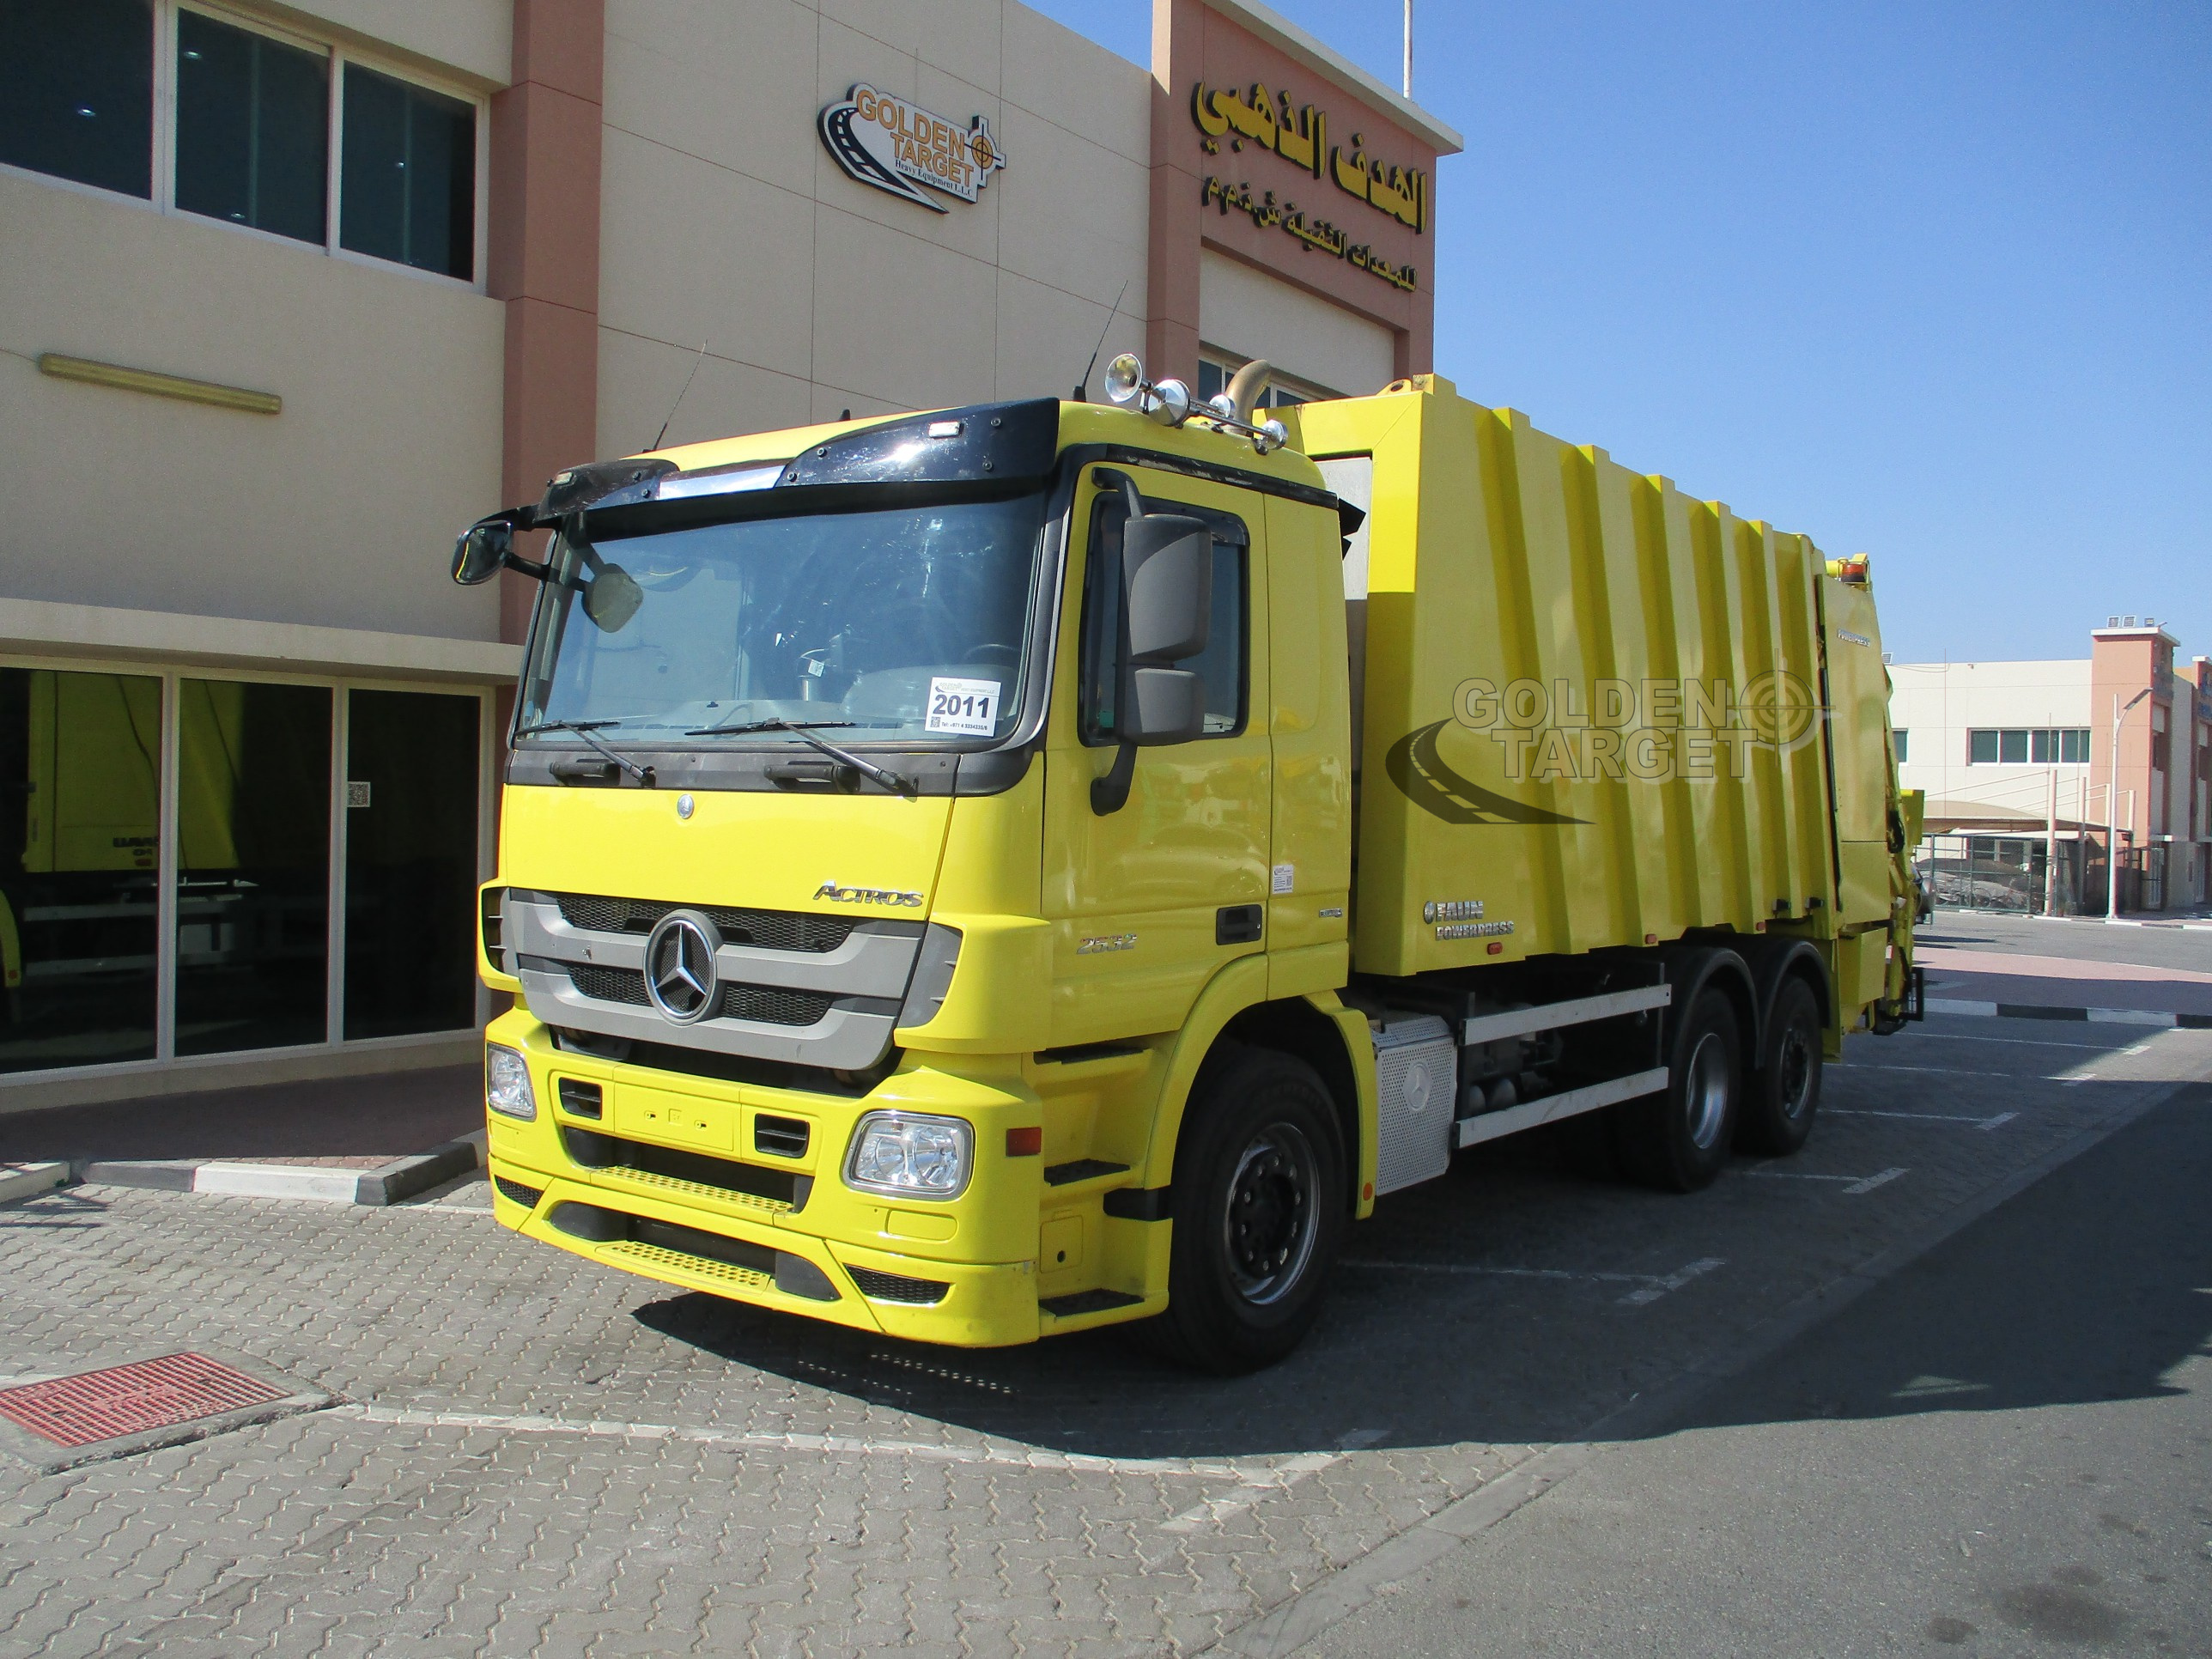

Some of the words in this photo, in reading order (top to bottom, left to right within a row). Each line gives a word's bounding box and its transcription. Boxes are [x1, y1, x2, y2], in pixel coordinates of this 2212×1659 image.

[857, 89, 965, 161] GOLDEN
[1191, 82, 1327, 179] الذهبي
[890, 131, 975, 187] TARGET
[895, 159, 916, 176] Heavy
[918, 168, 954, 189] Equipment
[1330, 133, 1427, 234] الهدف
[1281, 202, 1347, 259] الثقيلة
[933, 694, 990, 719] 2011
[1435, 901, 1484, 921] FAUN
[1435, 921, 1514, 941] POWERPRESS
[1076, 933, 1138, 955] 2532
